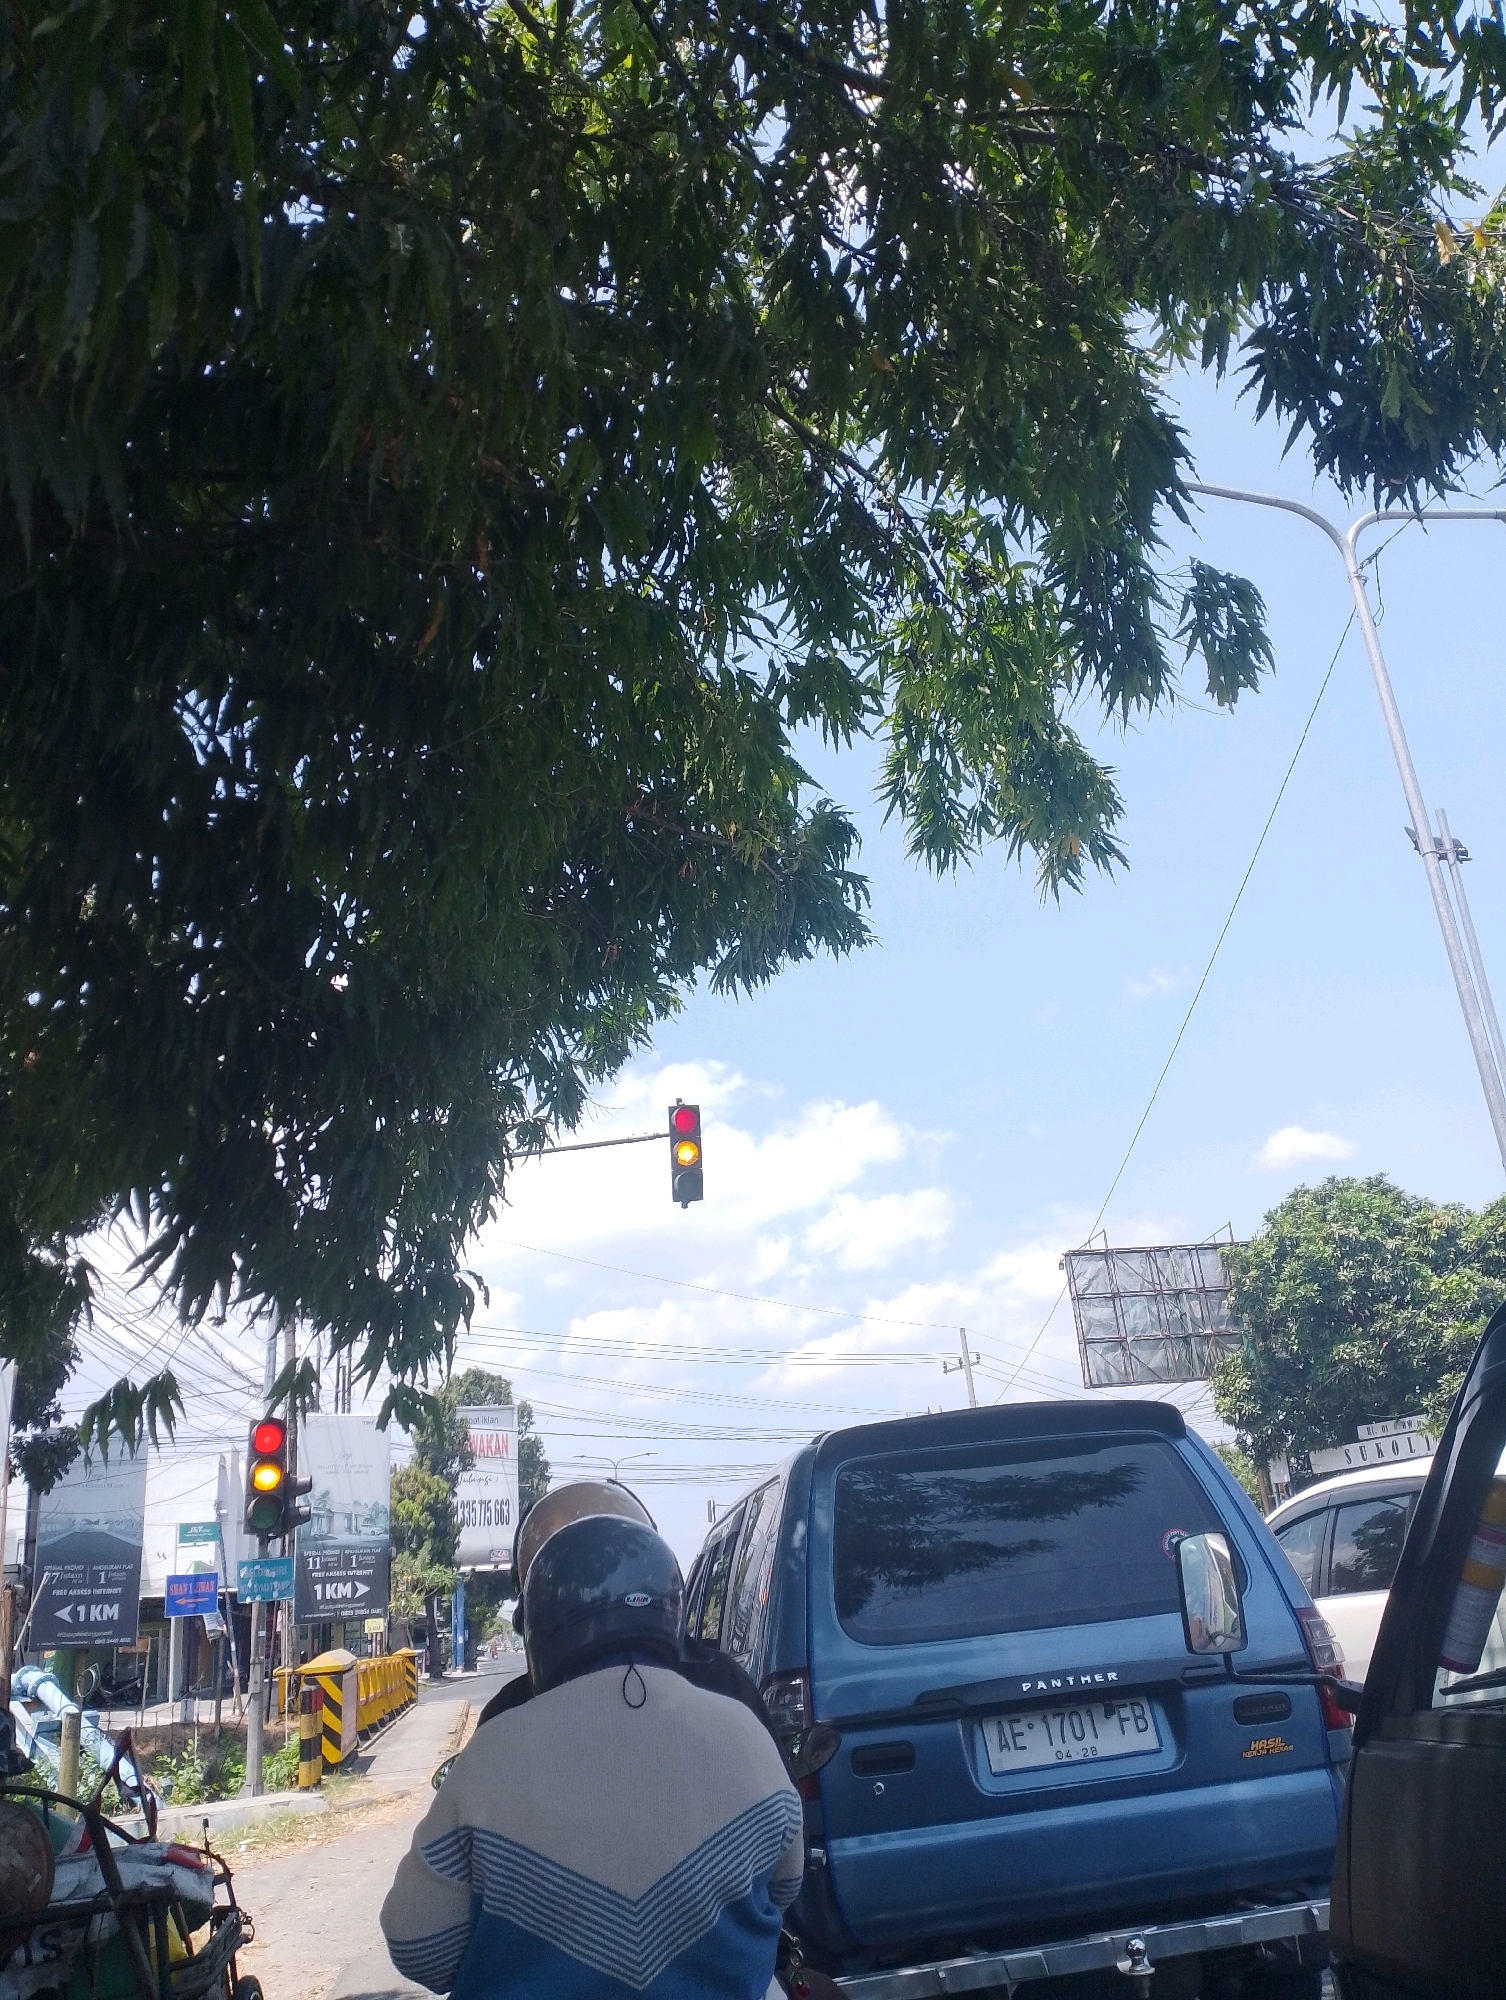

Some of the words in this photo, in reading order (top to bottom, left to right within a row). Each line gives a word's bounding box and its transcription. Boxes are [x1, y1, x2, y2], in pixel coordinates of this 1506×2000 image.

[481, 1415, 499, 1424] iklan
[467, 1432, 509, 1458] WAKAN
[306, 1556, 322, 1570] 11
[350, 1554, 358, 1568] 1
[98, 1570, 106, 1585] 1
[313, 1583, 322, 1601] 1
[325, 1581, 352, 1600] KM
[76, 1604, 86, 1622] 1
[89, 1603, 120, 1622] KM
[1021, 1671, 1119, 1692] PANTHER
[996, 1717, 1028, 1753] AE
[1041, 1708, 1099, 1747] 1701
[1114, 1701, 1150, 1736] FB
[1250, 1736, 1286, 1751] HASIL
[1242, 1749, 1268, 1759] KERJA
[1269, 1744, 1294, 1755] KERAS
